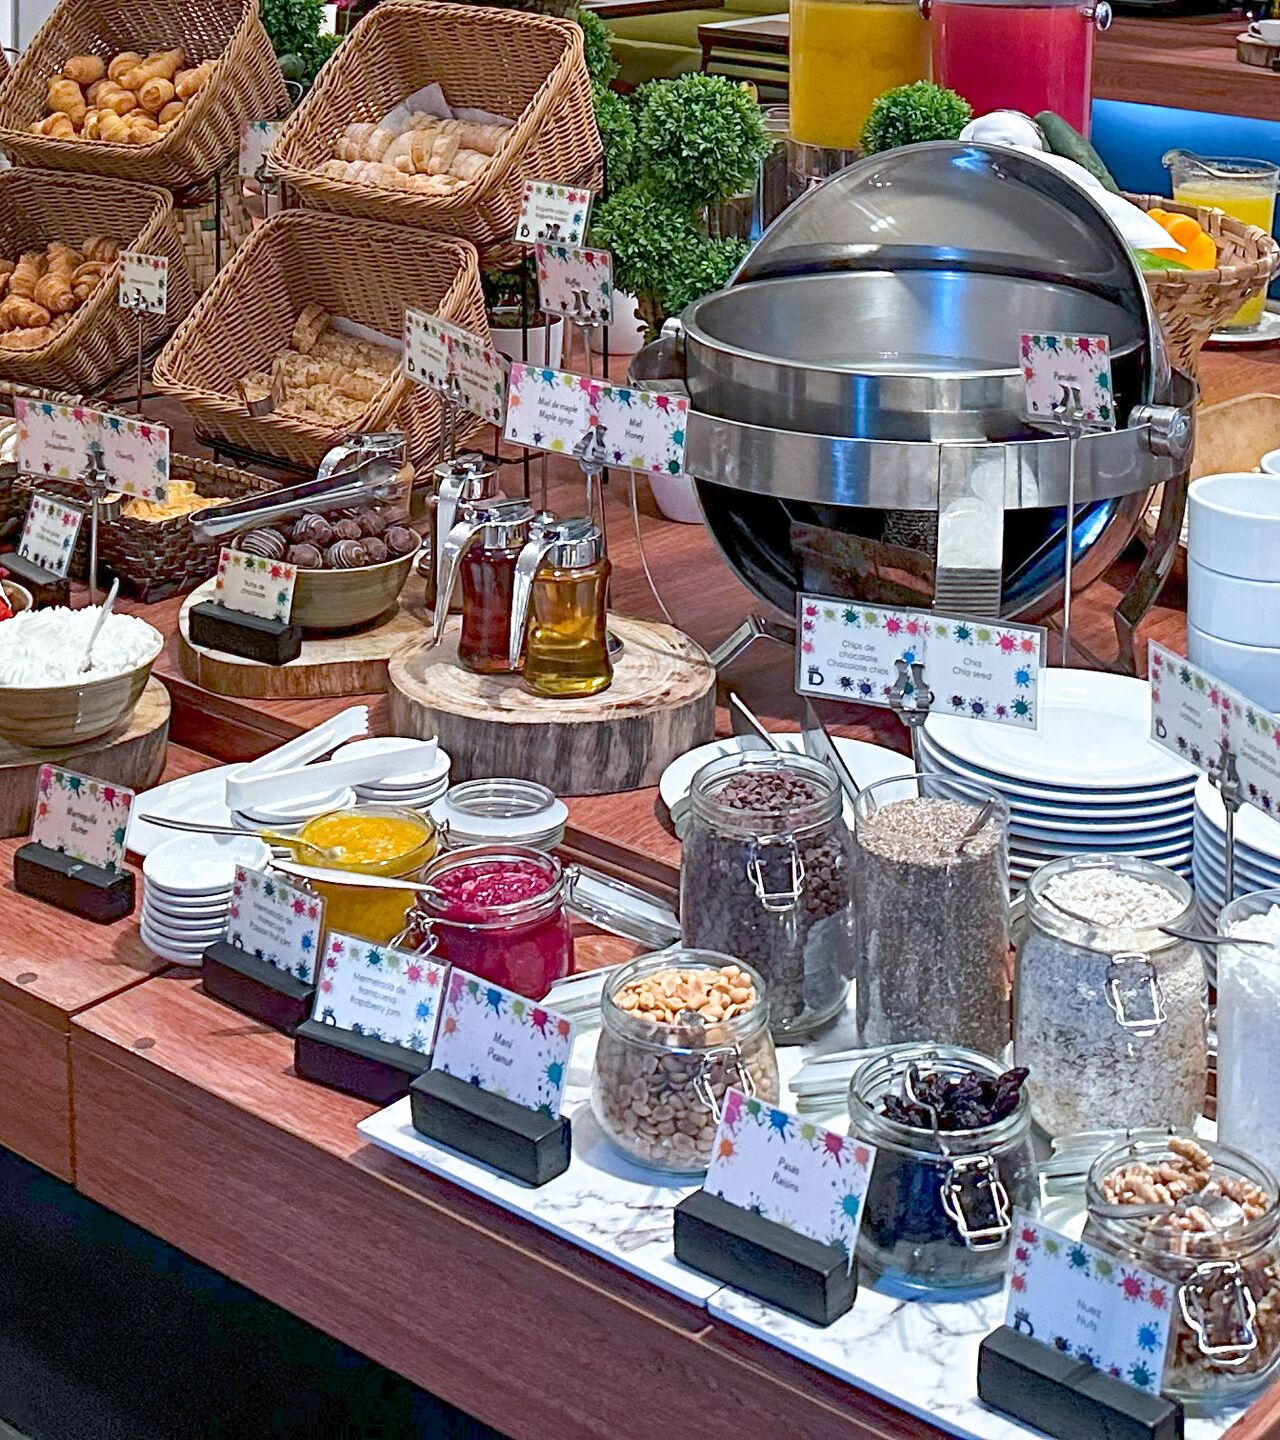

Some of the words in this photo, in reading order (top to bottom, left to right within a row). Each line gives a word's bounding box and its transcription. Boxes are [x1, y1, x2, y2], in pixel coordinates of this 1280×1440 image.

[537, 396, 552, 406] Miel
[552, 400, 560, 409] de
[560, 403, 578, 414] maple
[538, 410, 557, 422] Maple
[557, 415, 574, 427] syrup
[629, 418, 643, 427] Miel
[625, 429, 645, 443] Honey
[842, 639, 863, 651] Chips
[864, 644, 876, 653] de
[838, 651, 878, 664] chocolate
[962, 657, 982, 668] Chia
[826, 658, 868, 673] Chocolate
[868, 666, 890, 677] chips
[952, 666, 971, 678] Chia
[972, 670, 993, 681] seed
[487, 1047, 514, 1067] Peanut
[777, 1156, 800, 1176] Pasas
[772, 1171, 800, 1193] Raisins
[1076, 1299, 1102, 1319] Nuez
[1076, 1314, 1099, 1332] Nuts
